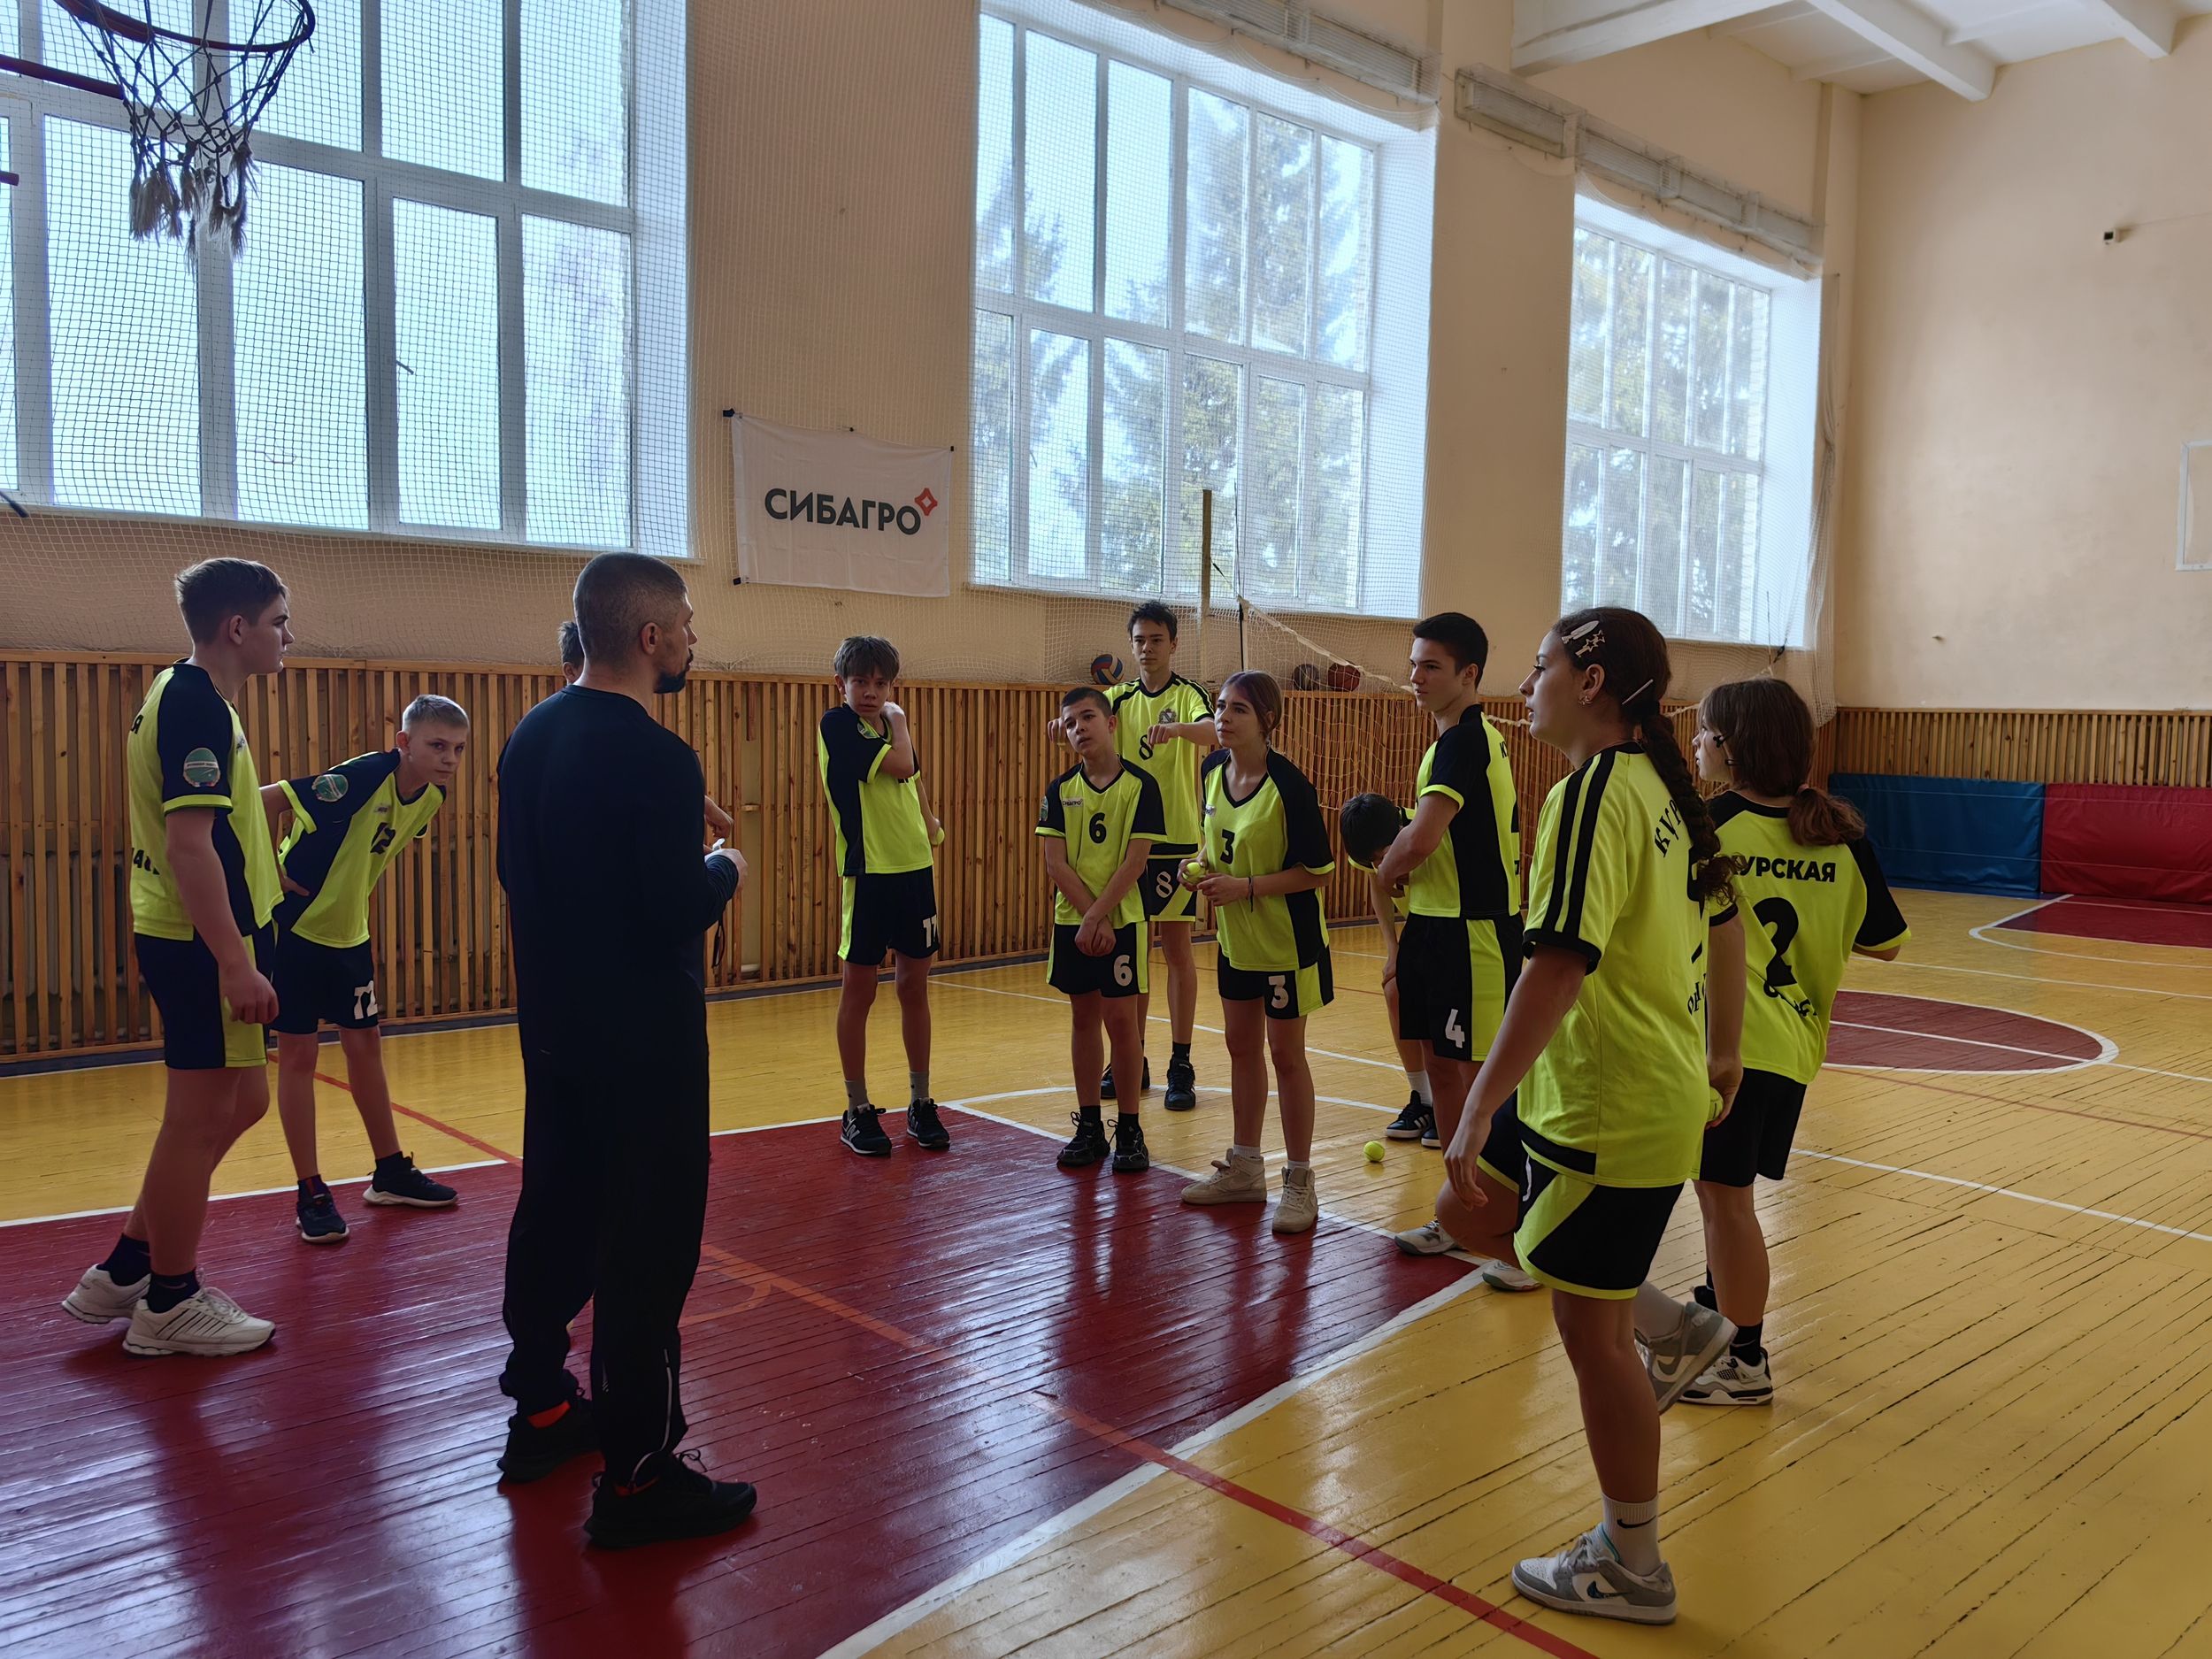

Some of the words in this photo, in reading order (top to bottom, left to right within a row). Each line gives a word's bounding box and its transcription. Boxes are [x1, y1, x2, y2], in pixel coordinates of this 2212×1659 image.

[764, 488, 921, 535] СИБАГРО
[1089, 812, 1107, 844] 6
[1220, 828, 1236, 865] 3
[1156, 871, 1172, 899] 8
[1753, 897, 1799, 987] 2
[1113, 954, 1133, 987] 6
[1268, 974, 1290, 1010] 3
[1445, 1008, 1465, 1048] 4
